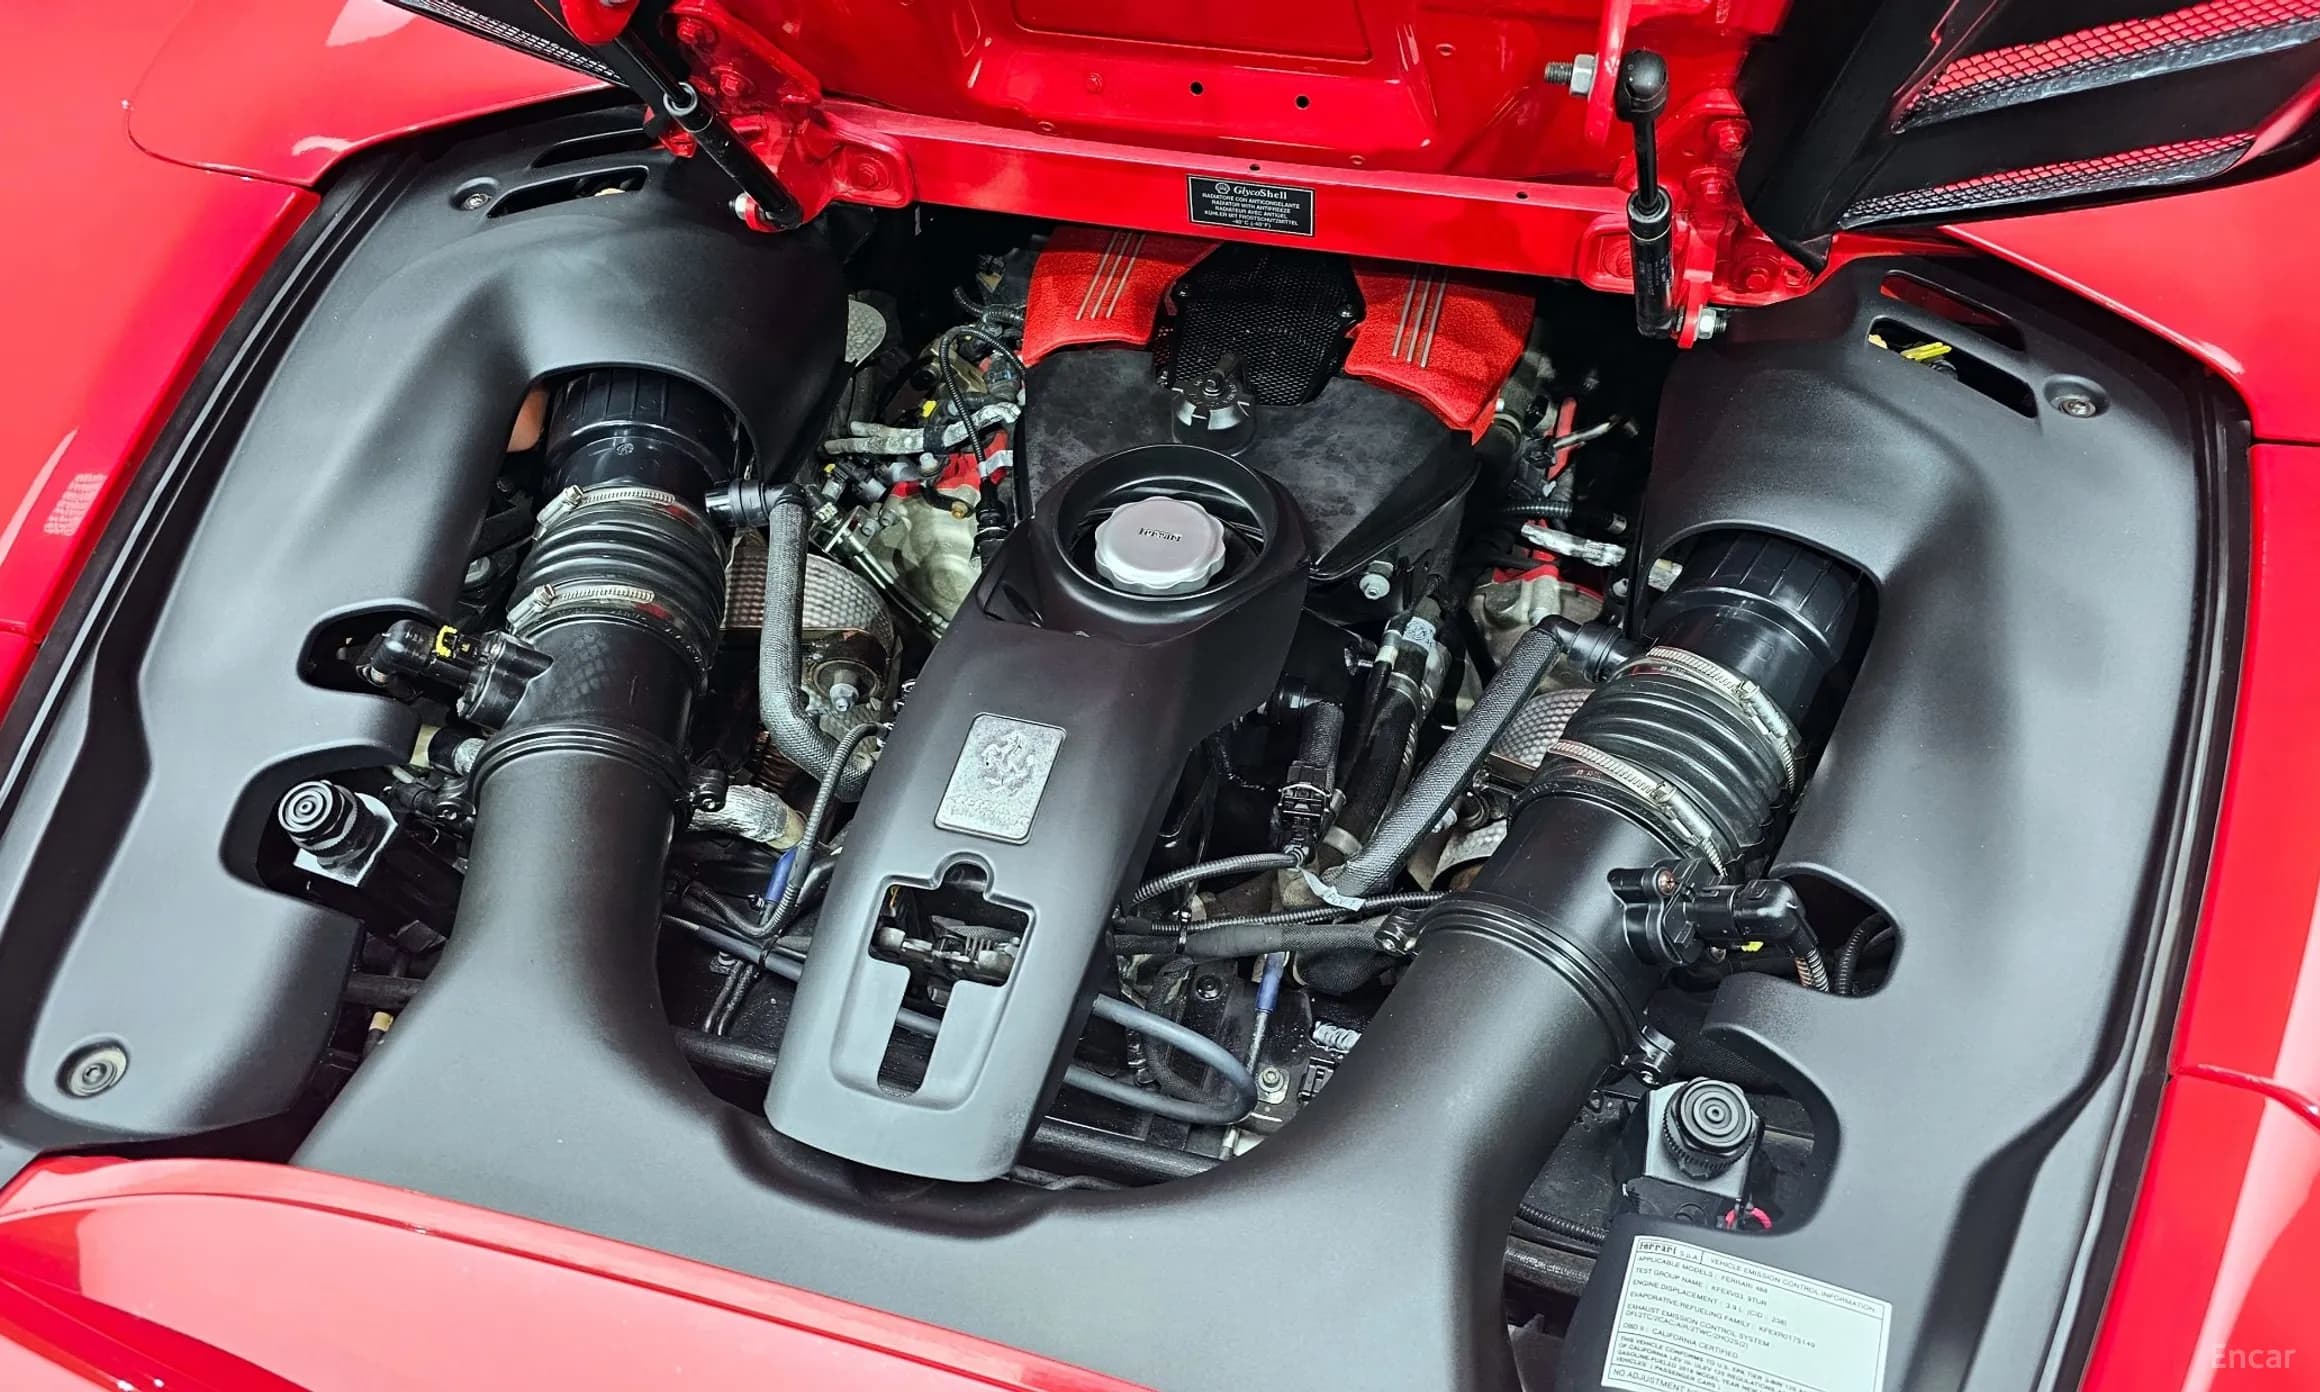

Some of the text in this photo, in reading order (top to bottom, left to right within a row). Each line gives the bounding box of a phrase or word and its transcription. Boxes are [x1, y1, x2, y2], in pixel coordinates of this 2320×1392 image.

[1233, 186, 1287, 200] GlycoShell
[1211, 200, 1240, 208] RADIATOR
[1639, 1241, 1677, 1254] Ferrari
[1638, 1256, 1680, 1268] APPLICABLE
[1636, 1266, 1653, 1274] TEST
[1654, 1268, 1681, 1281] GROUP
[1633, 1279, 1659, 1290] ENGINE
[1711, 1259, 1876, 1313] VEHICLE EMISSION CONTROL INFORMATION
[1627, 1303, 1771, 1348] EXHAUST EMISSION CONTROL SYSTEM
[1636, 1338, 1664, 1350] VEHICLE
[1651, 1327, 1697, 1346] CALIFORNIA
[1698, 1341, 1739, 1359] CERTIFIED
[1628, 1344, 1668, 1359] CALIFORNIA
[1613, 1368, 1686, 1392] NO ADJUSTMENT
